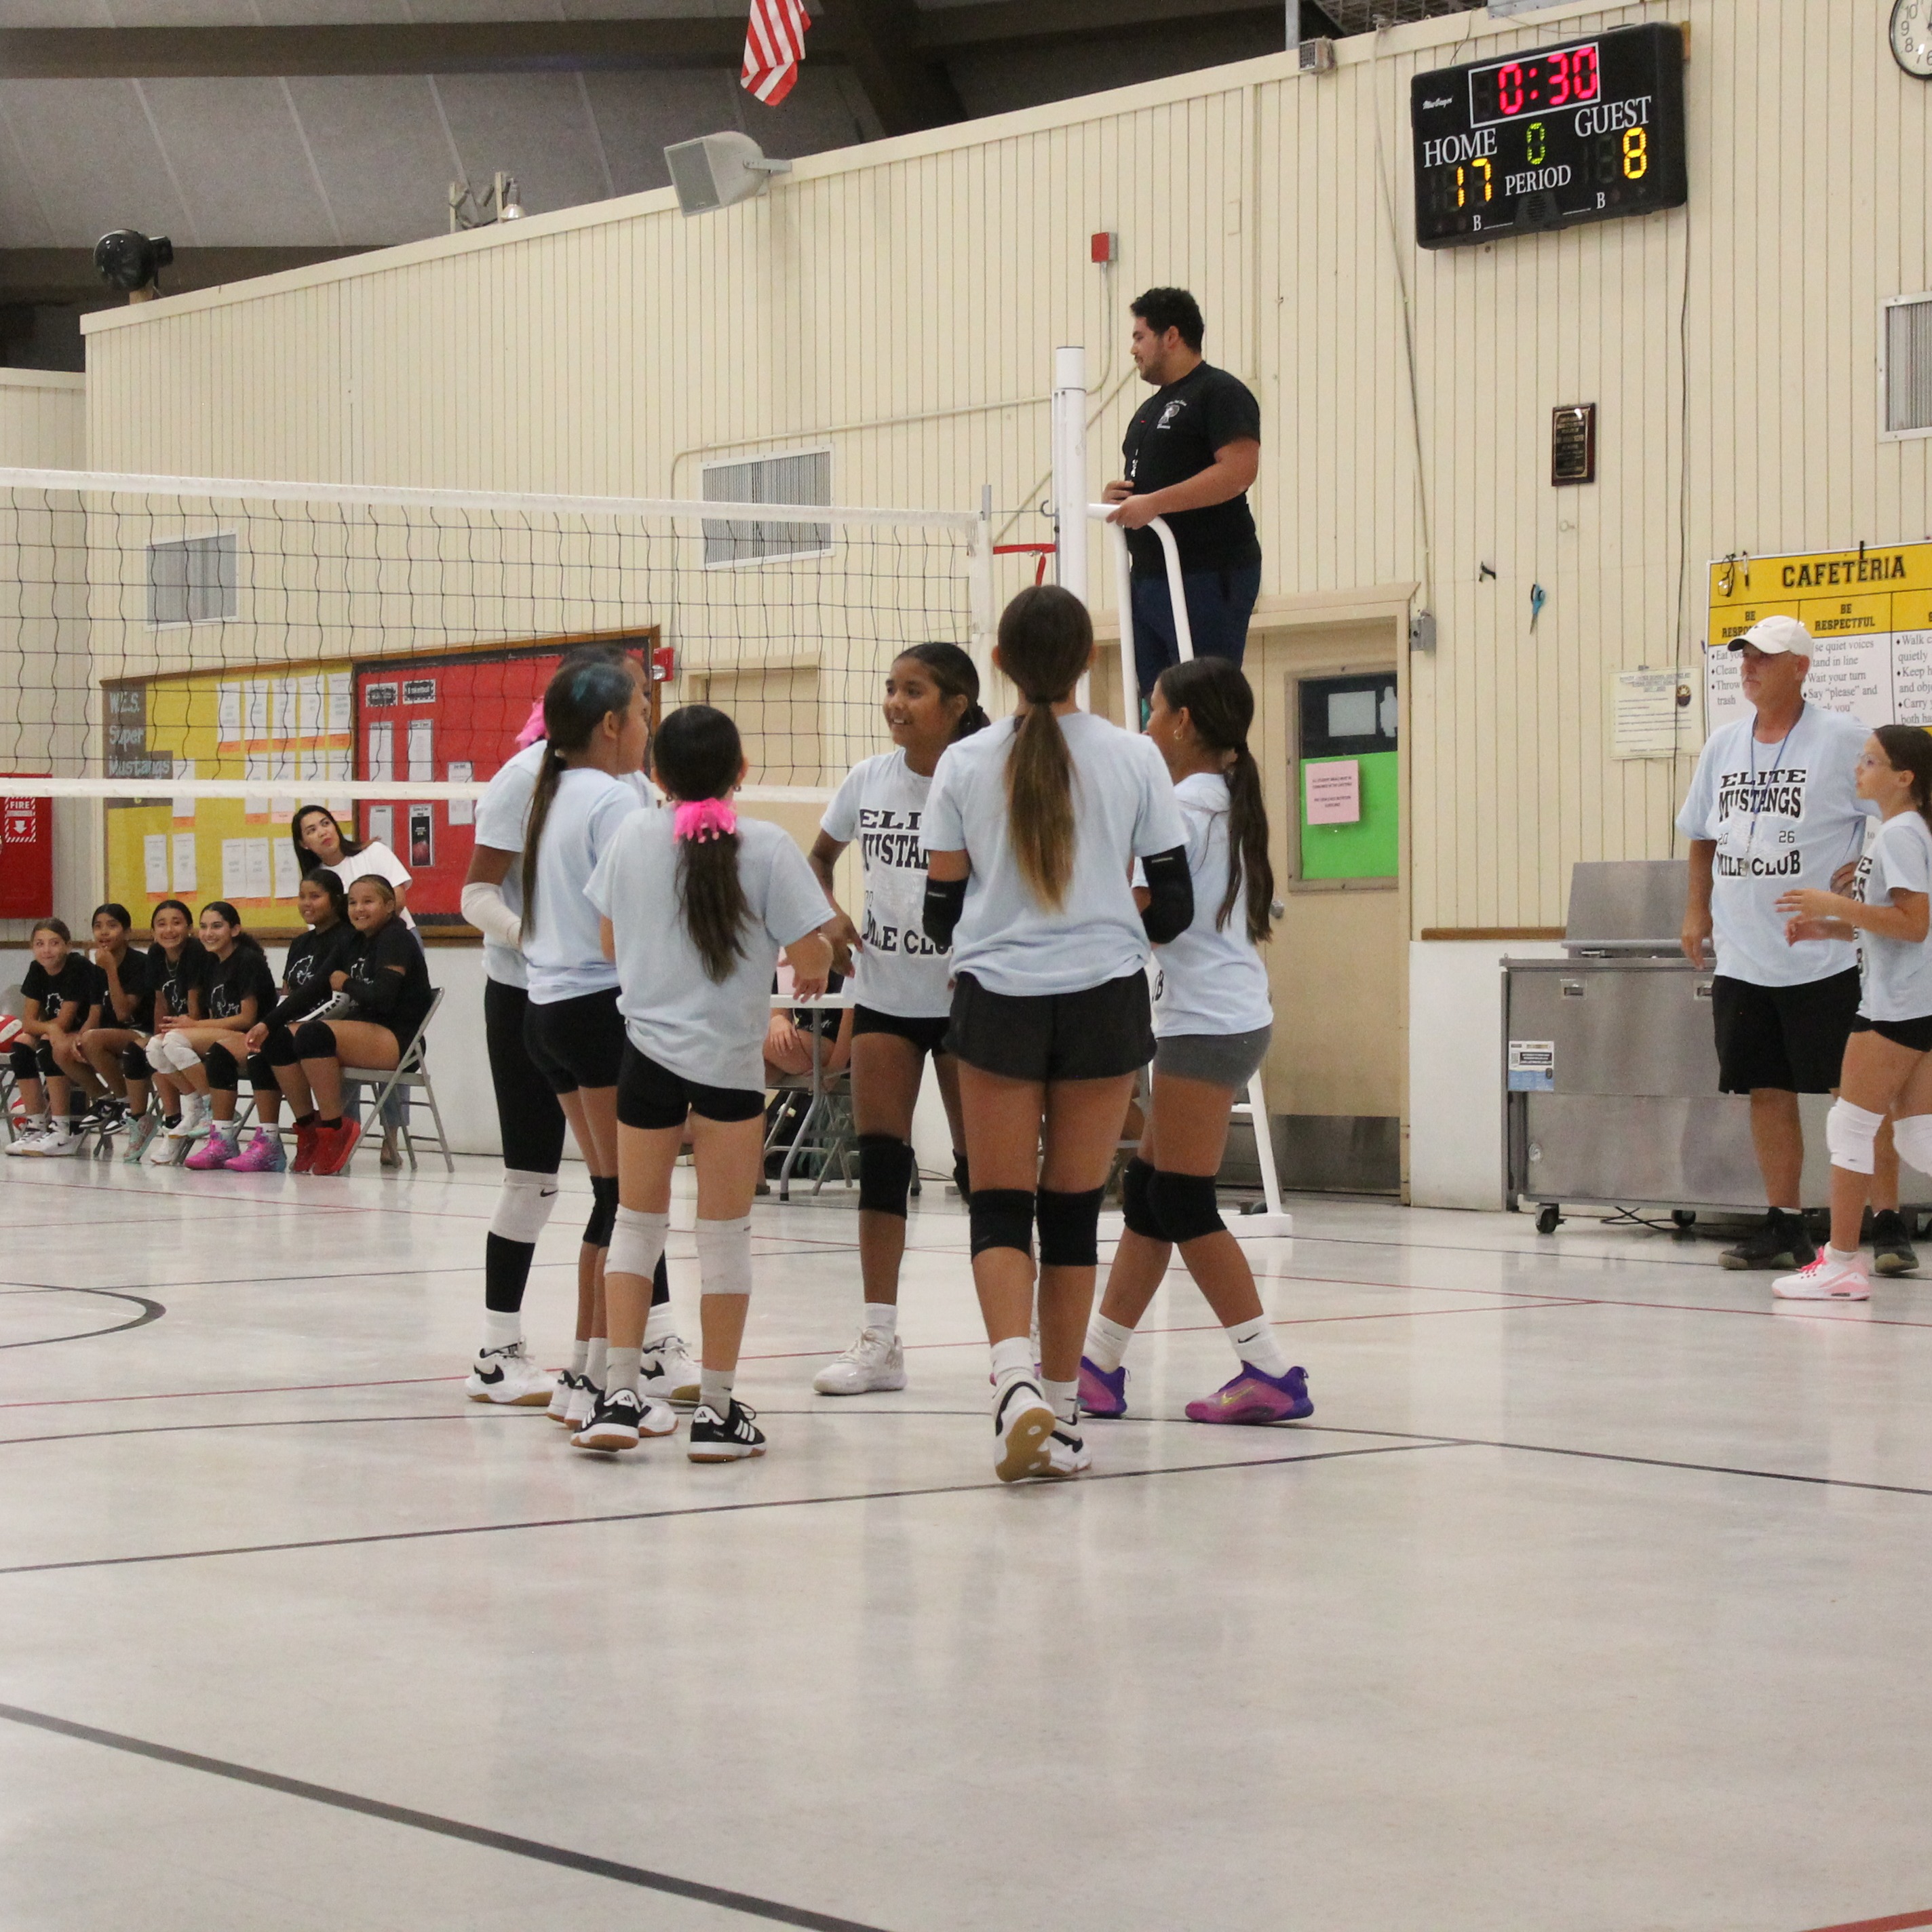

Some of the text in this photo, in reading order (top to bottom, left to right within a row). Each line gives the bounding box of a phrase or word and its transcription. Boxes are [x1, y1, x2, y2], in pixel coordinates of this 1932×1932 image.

[1901, 20, 1909, 36] 9
[1905, 37, 1913, 53] 8
[1498, 47, 1598, 115] 0:30
[1574, 96, 1651, 137] GUEST
[1423, 128, 1497, 168] HOME
[1526, 123, 1546, 165] 0
[1623, 127, 1647, 179] 8
[1456, 157, 1492, 208] 17
[1505, 164, 1572, 196] PERIOD
[1596, 192, 1606, 209] B
[1473, 214, 1482, 231] B
[1782, 555, 1906, 589] CAFETERIA
[1745, 611, 1756, 621] BE
[1840, 604, 1852, 615] BE
[1722, 625, 1752, 638] RESPO
[1815, 616, 1876, 632] RESPECTFUL
[1825, 640, 1847, 654] quiet
[1849, 639, 1874, 649] voices
[1902, 635, 1925, 646] Walk
[1716, 650, 1728, 661] Eat
[1812, 655, 1859, 668] tand in line
[1898, 649, 1928, 664] quietly
[1716, 665, 1737, 675] Clean
[1902, 666, 1925, 679] Keep
[1716, 680, 1741, 690] Throw
[1808, 672, 1866, 685] Wait your turn
[1808, 688, 1823, 701] Say
[1862, 684, 1878, 695] and
[1899, 681, 1914, 693] and
[1717, 694, 1736, 705] trash
[1904, 698, 1927, 710] Carry
[1901, 714, 1920, 724] both
[109, 725, 144, 752] Super
[109, 756, 171, 779] Mustangs
[1721, 769, 1807, 788] ELITE
[10, 800, 31, 809] FIRE
[1719, 787, 1802, 822] MUSTANGS
[859, 809, 921, 830] ELI
[1779, 830, 1795, 843] 26
[1752, 849, 1801, 876] CLUB
[904, 929, 954, 955] CLU
